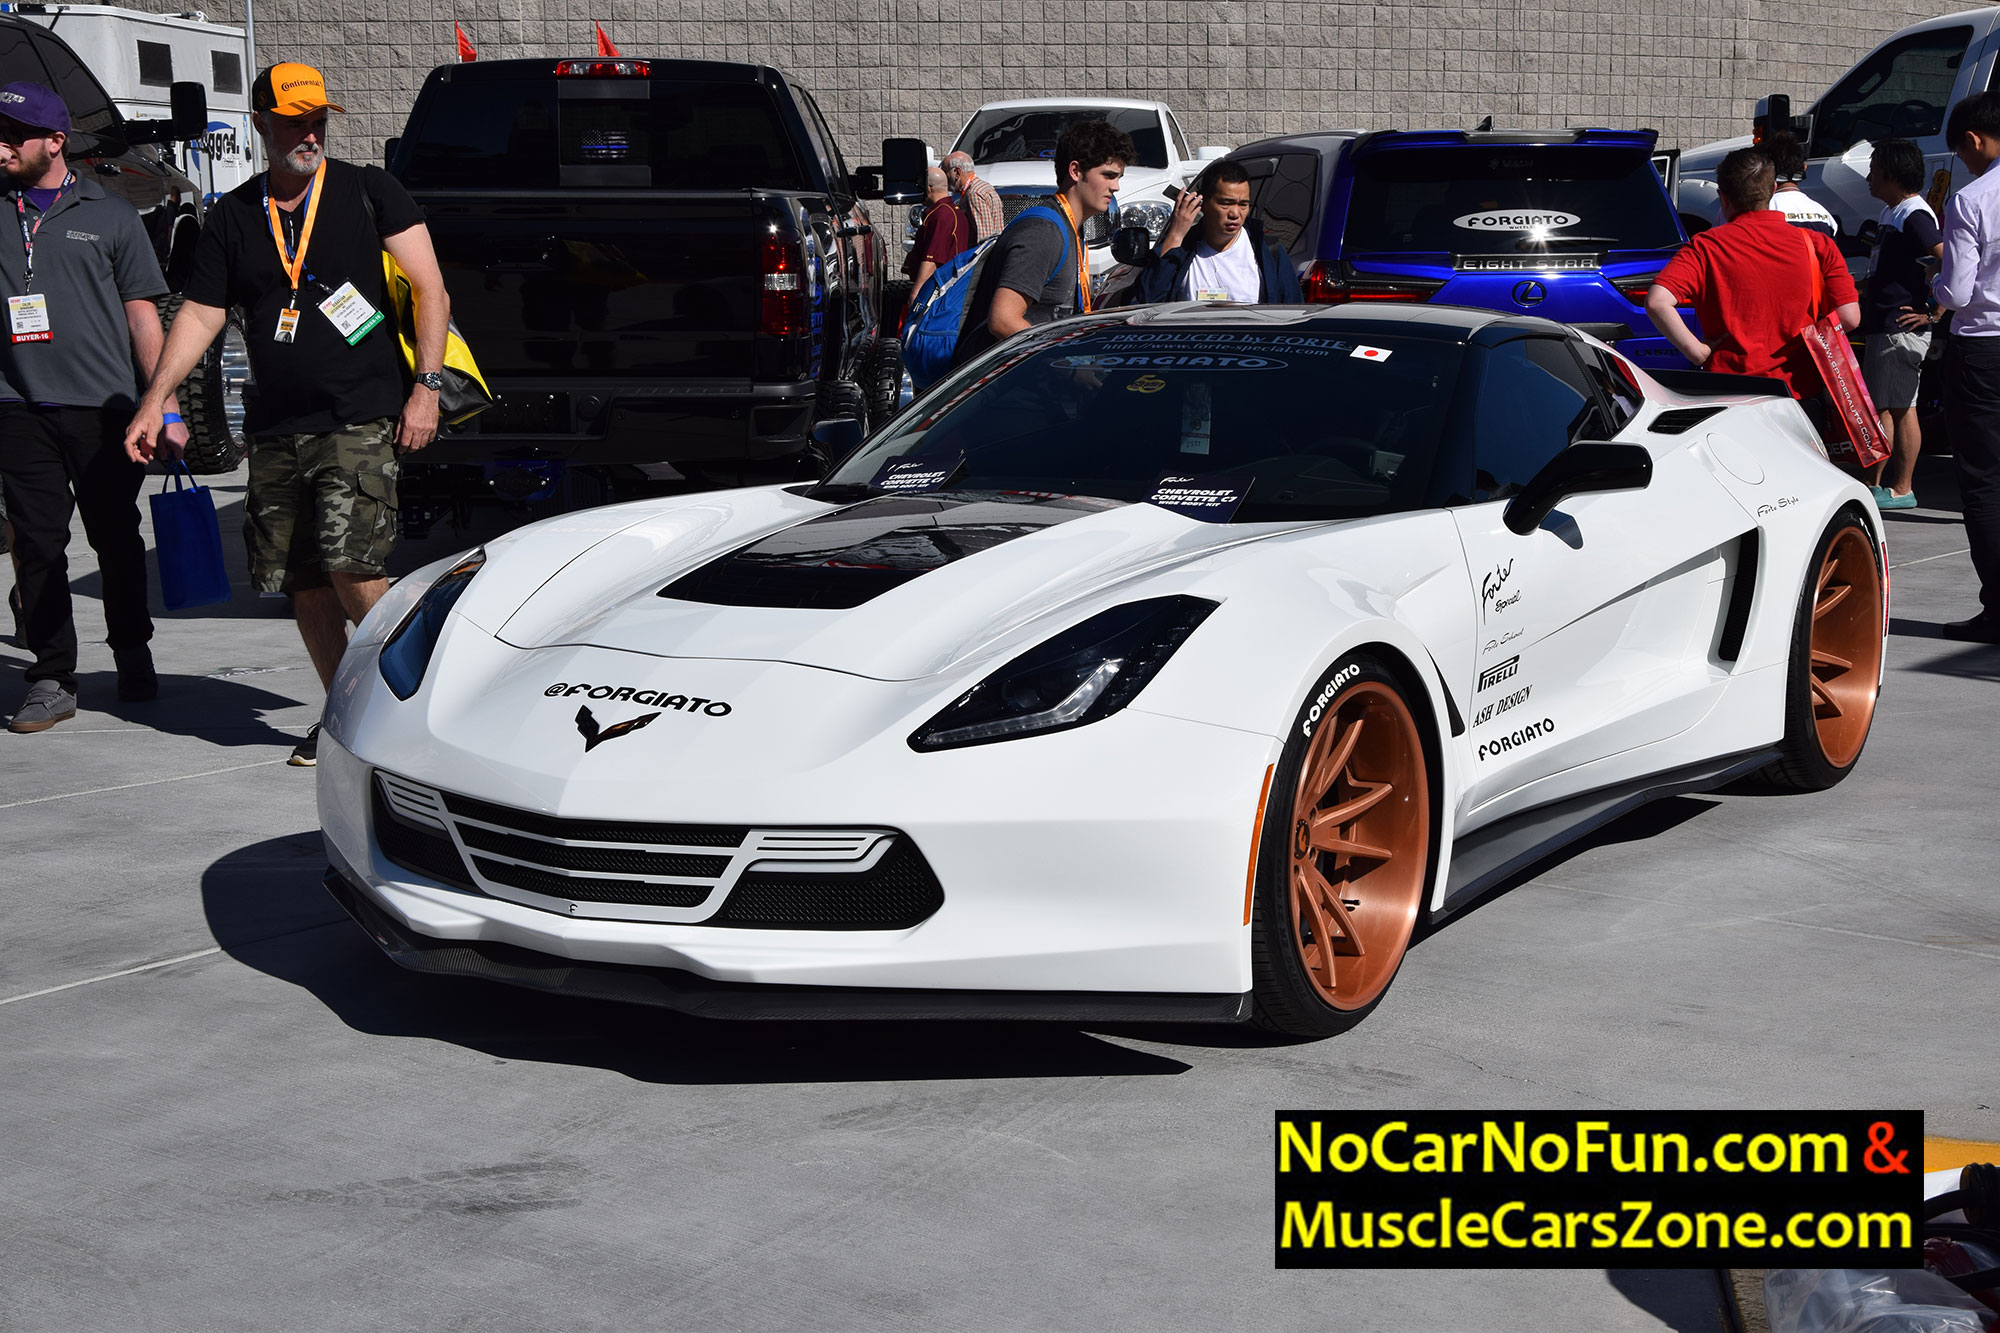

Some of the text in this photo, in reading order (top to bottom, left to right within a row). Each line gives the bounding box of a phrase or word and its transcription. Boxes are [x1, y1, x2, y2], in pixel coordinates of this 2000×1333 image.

[1467, 215, 1569, 228] FORGIATO
[1536, 259, 1594, 270] STAR
[16, 333, 49, 342] BUYER-16
[1110, 333, 1236, 343] PRODUCED
[1240, 334, 1260, 344] by
[1817, 333, 1873, 451] WWW.SPYDERAUTO.COM
[880, 478, 931, 486] CORVETTE
[1151, 494, 1218, 502] CORVETTE
[1157, 488, 1234, 496] CHEVROLET
[1477, 655, 1520, 693] PIRELLI
[543, 682, 733, 717] @FORGIATO
[1302, 663, 1361, 738] FORGIATO
[1472, 684, 1533, 729] ASH DESIGN
[1478, 717, 1555, 762] FORGIATO
